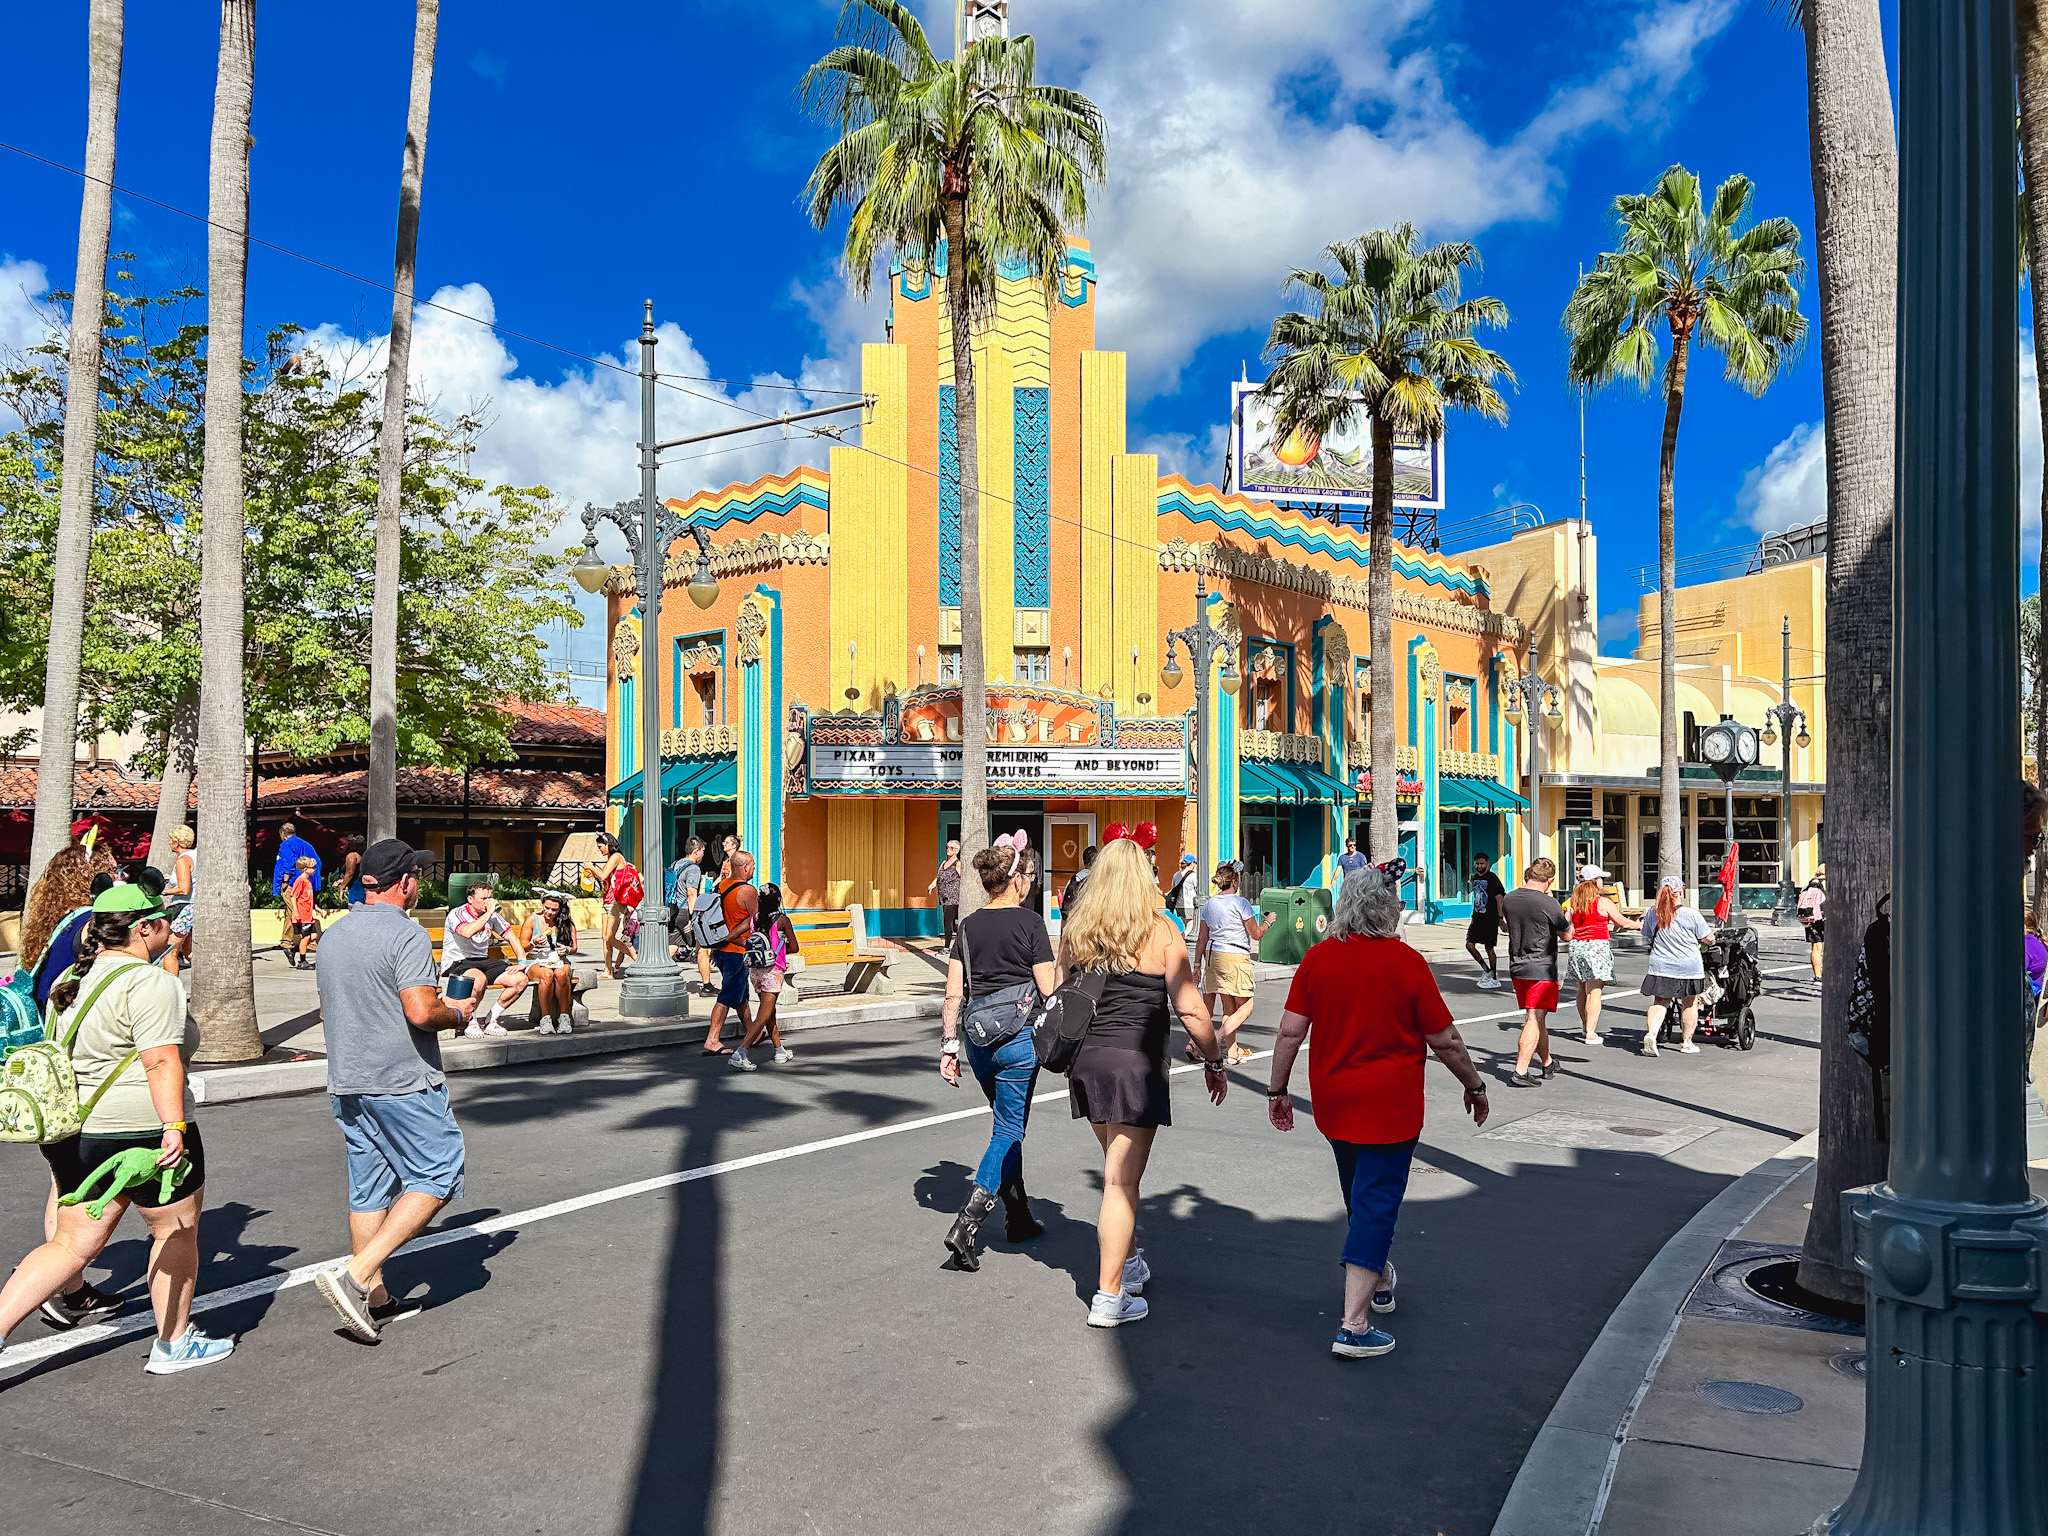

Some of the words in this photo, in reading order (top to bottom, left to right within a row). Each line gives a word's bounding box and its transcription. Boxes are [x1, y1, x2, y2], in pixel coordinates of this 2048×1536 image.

[1288, 487, 1320, 495] CALIFORNIA
[1350, 490, 1367, 498] LITTLE
[1394, 493, 1420, 501] SUNSHINE
[833, 750, 875, 761] PIXAR
[986, 751, 1048, 763] REMIERING
[1075, 760, 1099, 771] AND
[1107, 760, 1159, 771] BEYOND!
